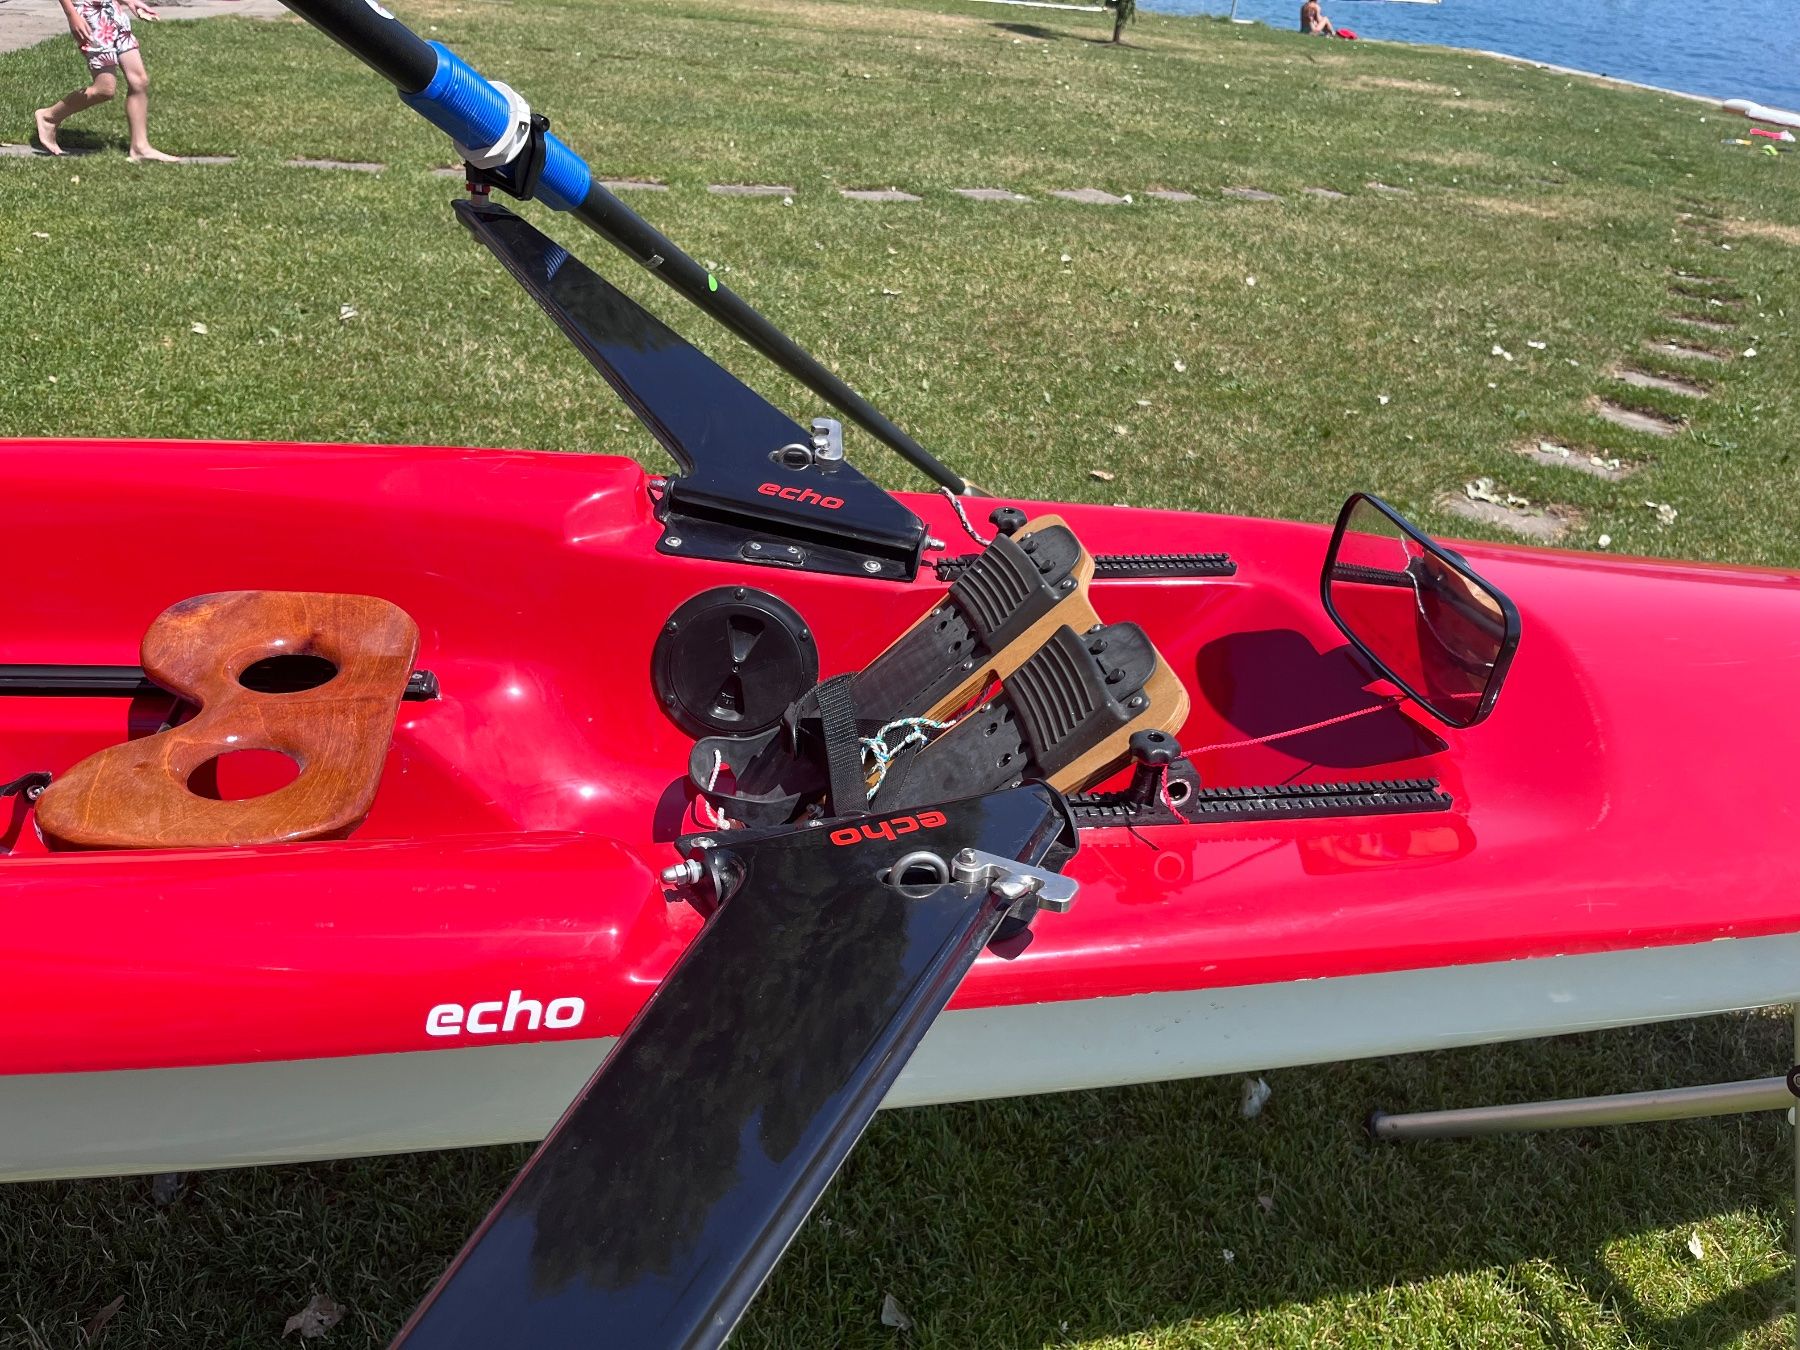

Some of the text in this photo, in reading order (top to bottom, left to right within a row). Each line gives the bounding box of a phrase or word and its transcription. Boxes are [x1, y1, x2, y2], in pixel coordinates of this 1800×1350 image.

[758, 483, 844, 509] echo
[830, 811, 947, 845] echo
[426, 990, 584, 1035] echo
